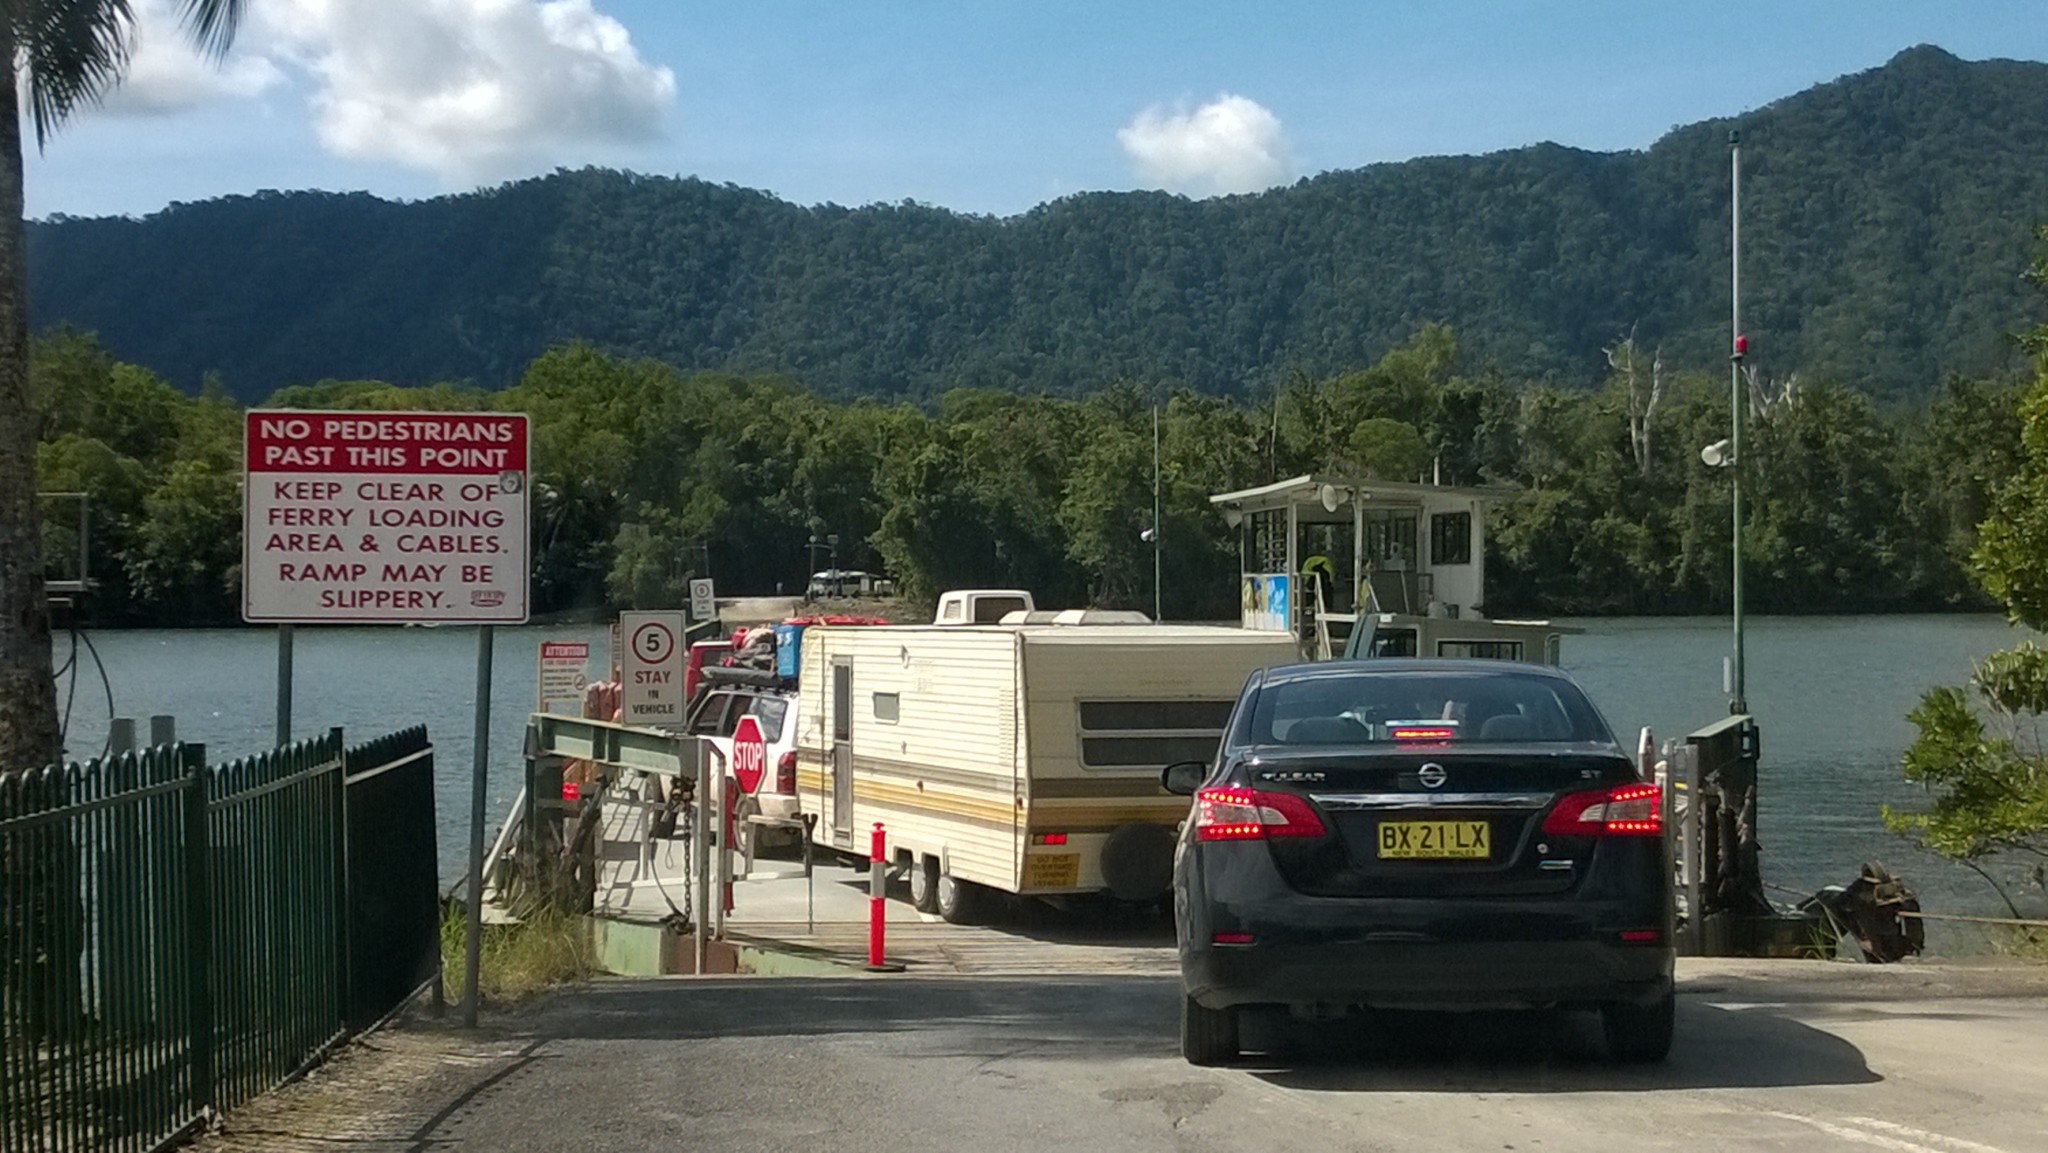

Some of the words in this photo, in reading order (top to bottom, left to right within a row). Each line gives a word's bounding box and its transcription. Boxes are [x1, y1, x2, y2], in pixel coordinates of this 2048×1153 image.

[260, 420, 310, 439] NO
[324, 421, 513, 442] PEDESTRIANS
[265, 447, 335, 465] PAST
[346, 447, 406, 467] THIS
[420, 449, 509, 468] POINT
[274, 482, 342, 500] KEEP
[357, 483, 444, 501] CLEAR
[460, 484, 498, 502] OF
[268, 508, 354, 526] FERRY
[369, 509, 504, 528] LOADING
[265, 534, 343, 551] AREA
[359, 534, 380, 552] &
[397, 535, 508, 554] CABLES.
[279, 564, 367, 582] RAMP
[382, 564, 447, 582] MAY
[461, 565, 493, 583] BE
[545, 646, 587, 656] ATTENTION
[646, 633, 660, 652] 5
[635, 670, 671, 684] STAY
[648, 689, 659, 699] IN
[632, 703, 675, 714] VEHICLE
[734, 741, 763, 771] STOP
[1581, 769, 1602, 778] ST
